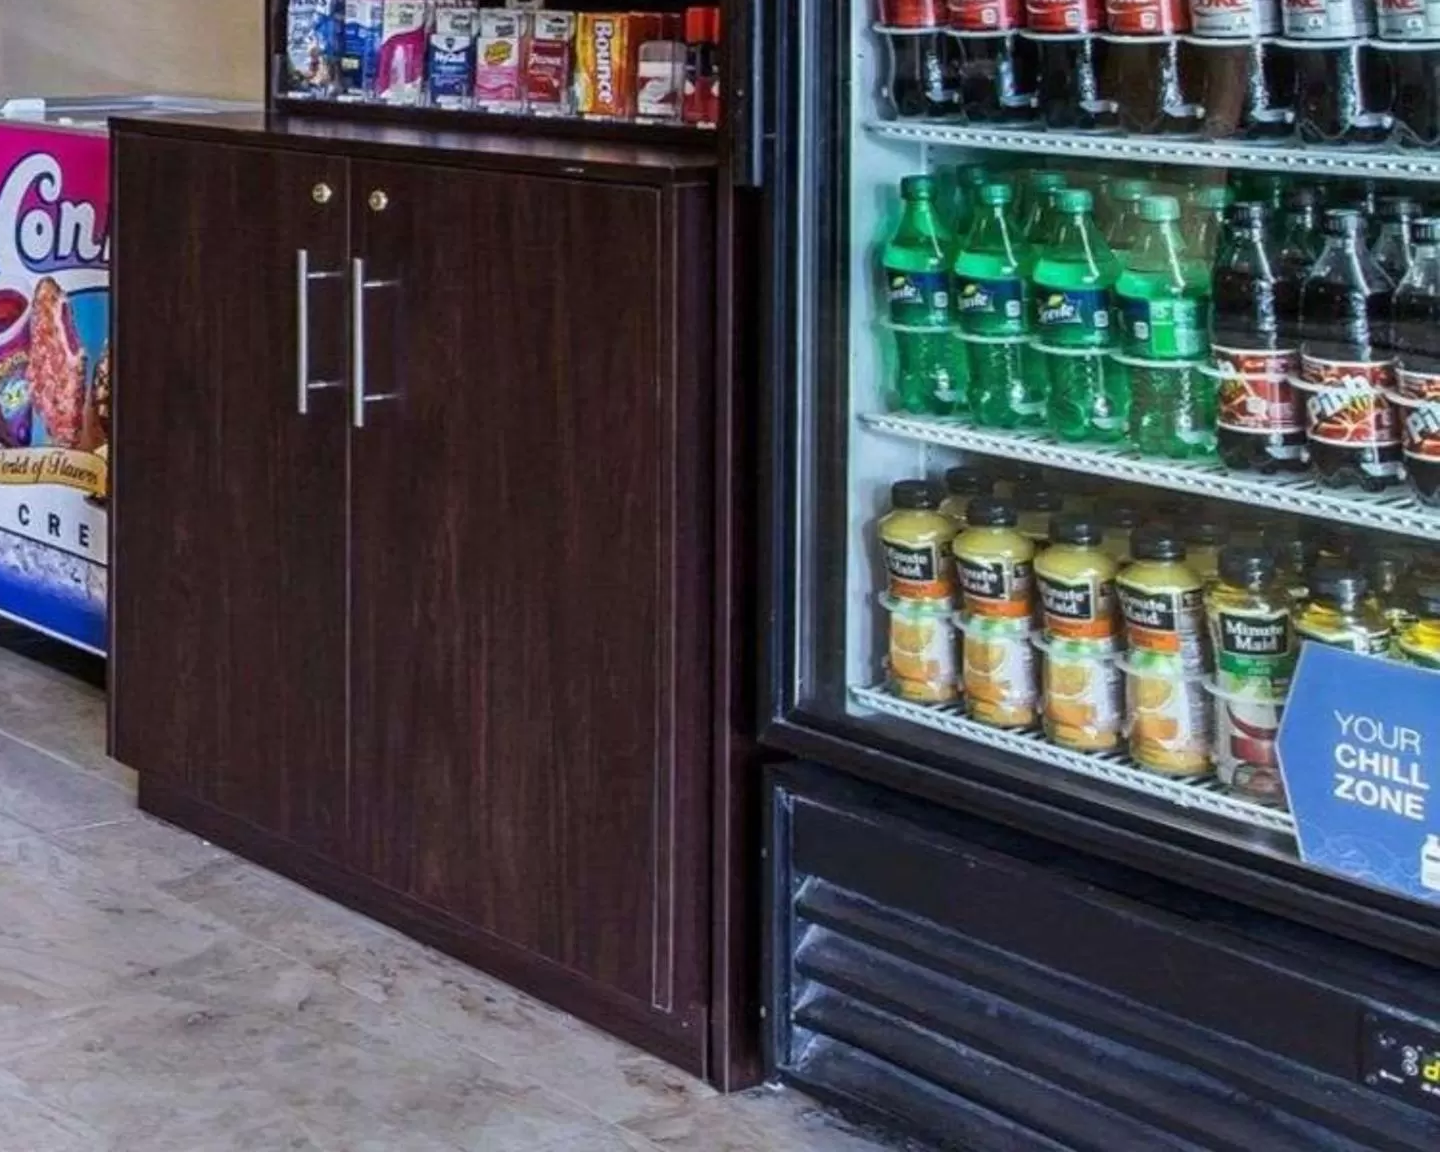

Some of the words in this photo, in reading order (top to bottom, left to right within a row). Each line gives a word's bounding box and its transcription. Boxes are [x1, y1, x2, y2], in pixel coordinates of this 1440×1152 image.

[593, 19, 615, 105] Bounce
[32, 455, 47, 482] of
[17, 503, 90, 549] CRE
[1225, 619, 1284, 636] Minute
[1234, 635, 1278, 650] Maid
[1333, 709, 1423, 756] YOUR
[1333, 742, 1431, 791] CHILL
[1333, 773, 1426, 821] ZONE
